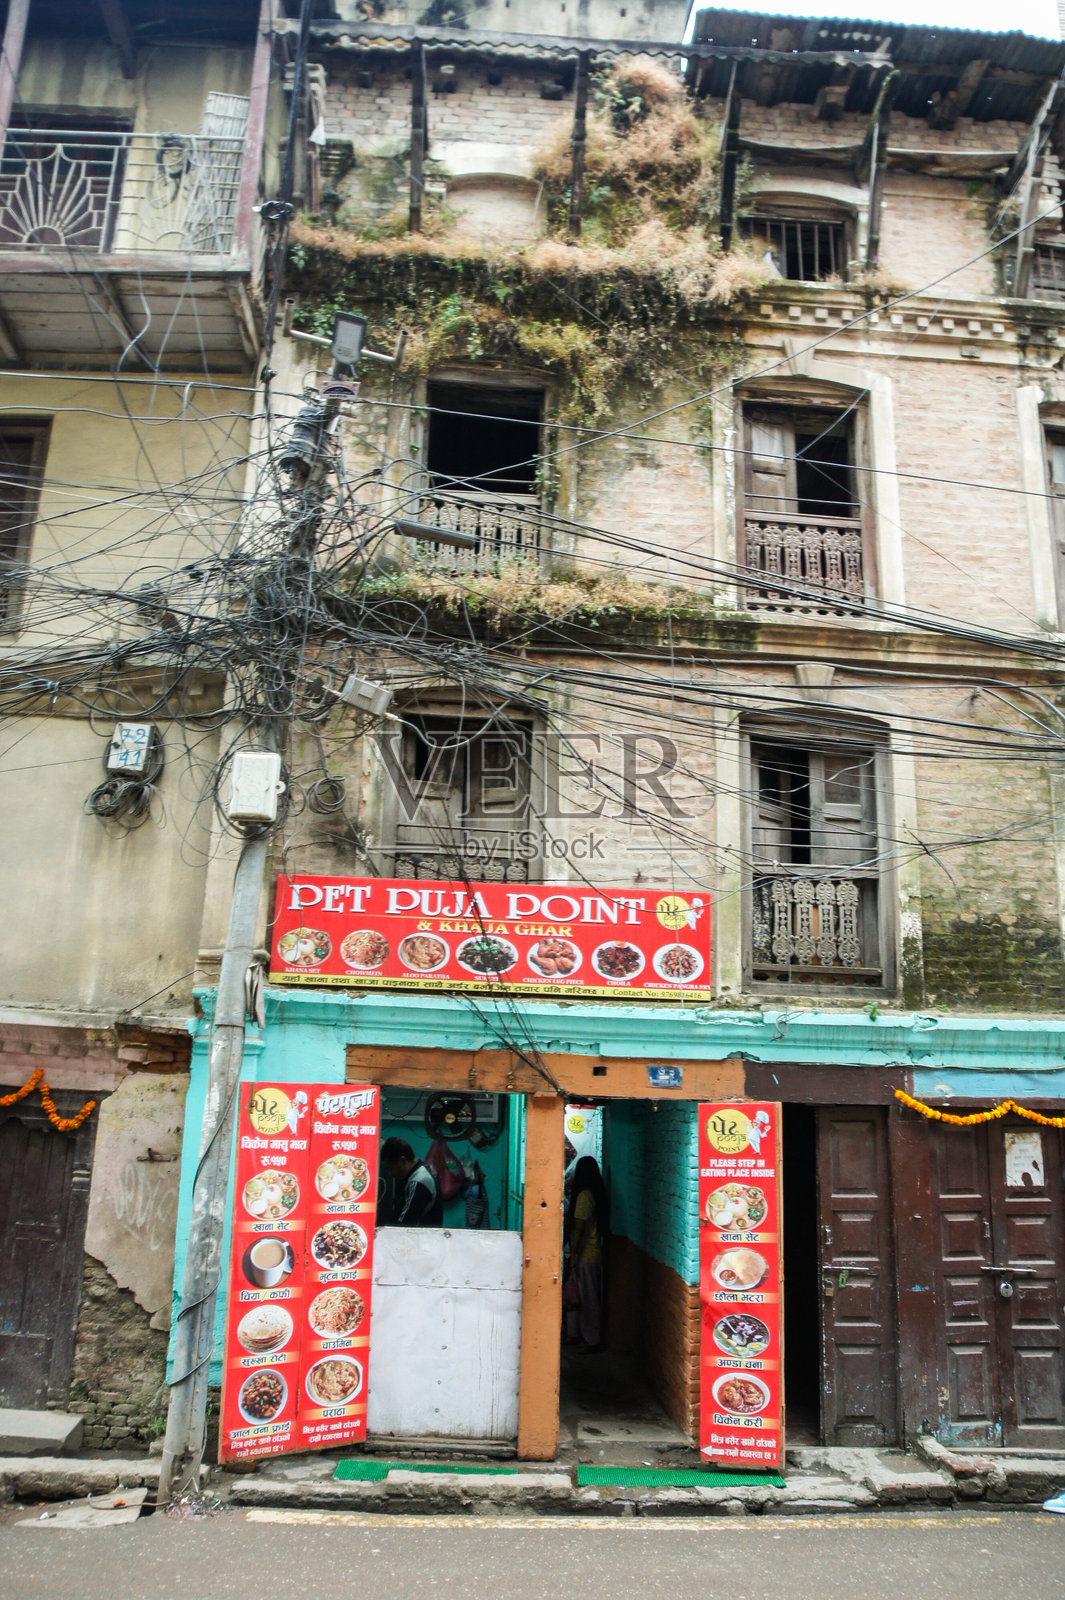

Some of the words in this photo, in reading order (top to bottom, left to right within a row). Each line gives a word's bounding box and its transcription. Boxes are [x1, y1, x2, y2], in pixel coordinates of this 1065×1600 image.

[288, 884, 371, 914] PET
[385, 888, 492, 918] PUJA
[505, 893, 646, 925] POINT
[417, 920, 433, 931] &
[438, 920, 509, 935] KHAJA
[514, 924, 574, 937] GHAR
[612, 989, 643, 997] Contact
[710, 1158, 736, 1168] PLEASE
[737, 1158, 756, 1168] STEP
[757, 1159, 765, 1168] IN
[701, 1168, 726, 1177] EATING
[727, 1168, 750, 1177] PLACE
[751, 1168, 775, 1178] INSIDE
[326, 1204, 346, 1213] खाना
[253, 1223, 273, 1231] खाना
[720, 1232, 742, 1242] खाना
[745, 1231, 760, 1242] सेट
[745, 1360, 763, 1369] चना
